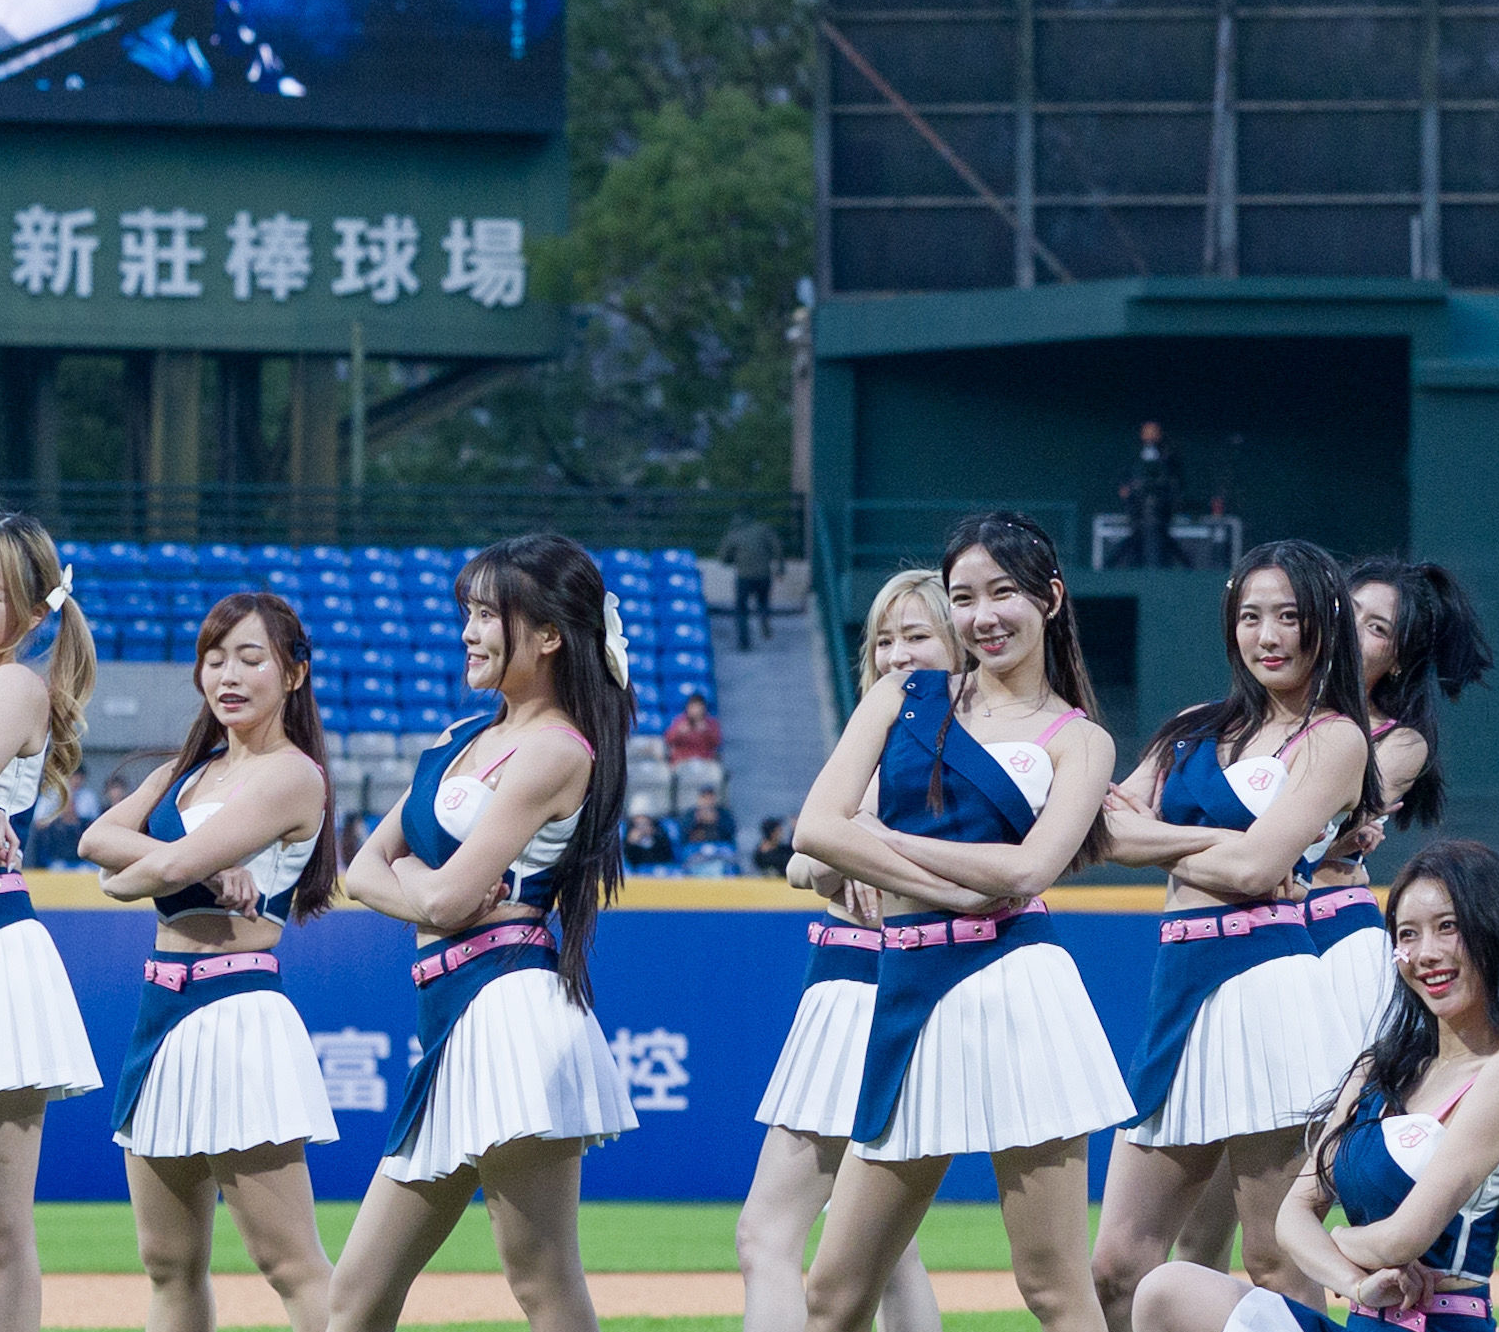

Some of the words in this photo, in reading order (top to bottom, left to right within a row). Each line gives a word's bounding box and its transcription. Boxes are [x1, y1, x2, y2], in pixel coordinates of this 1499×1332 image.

[11, 204, 528, 307] 新莊棒球場
